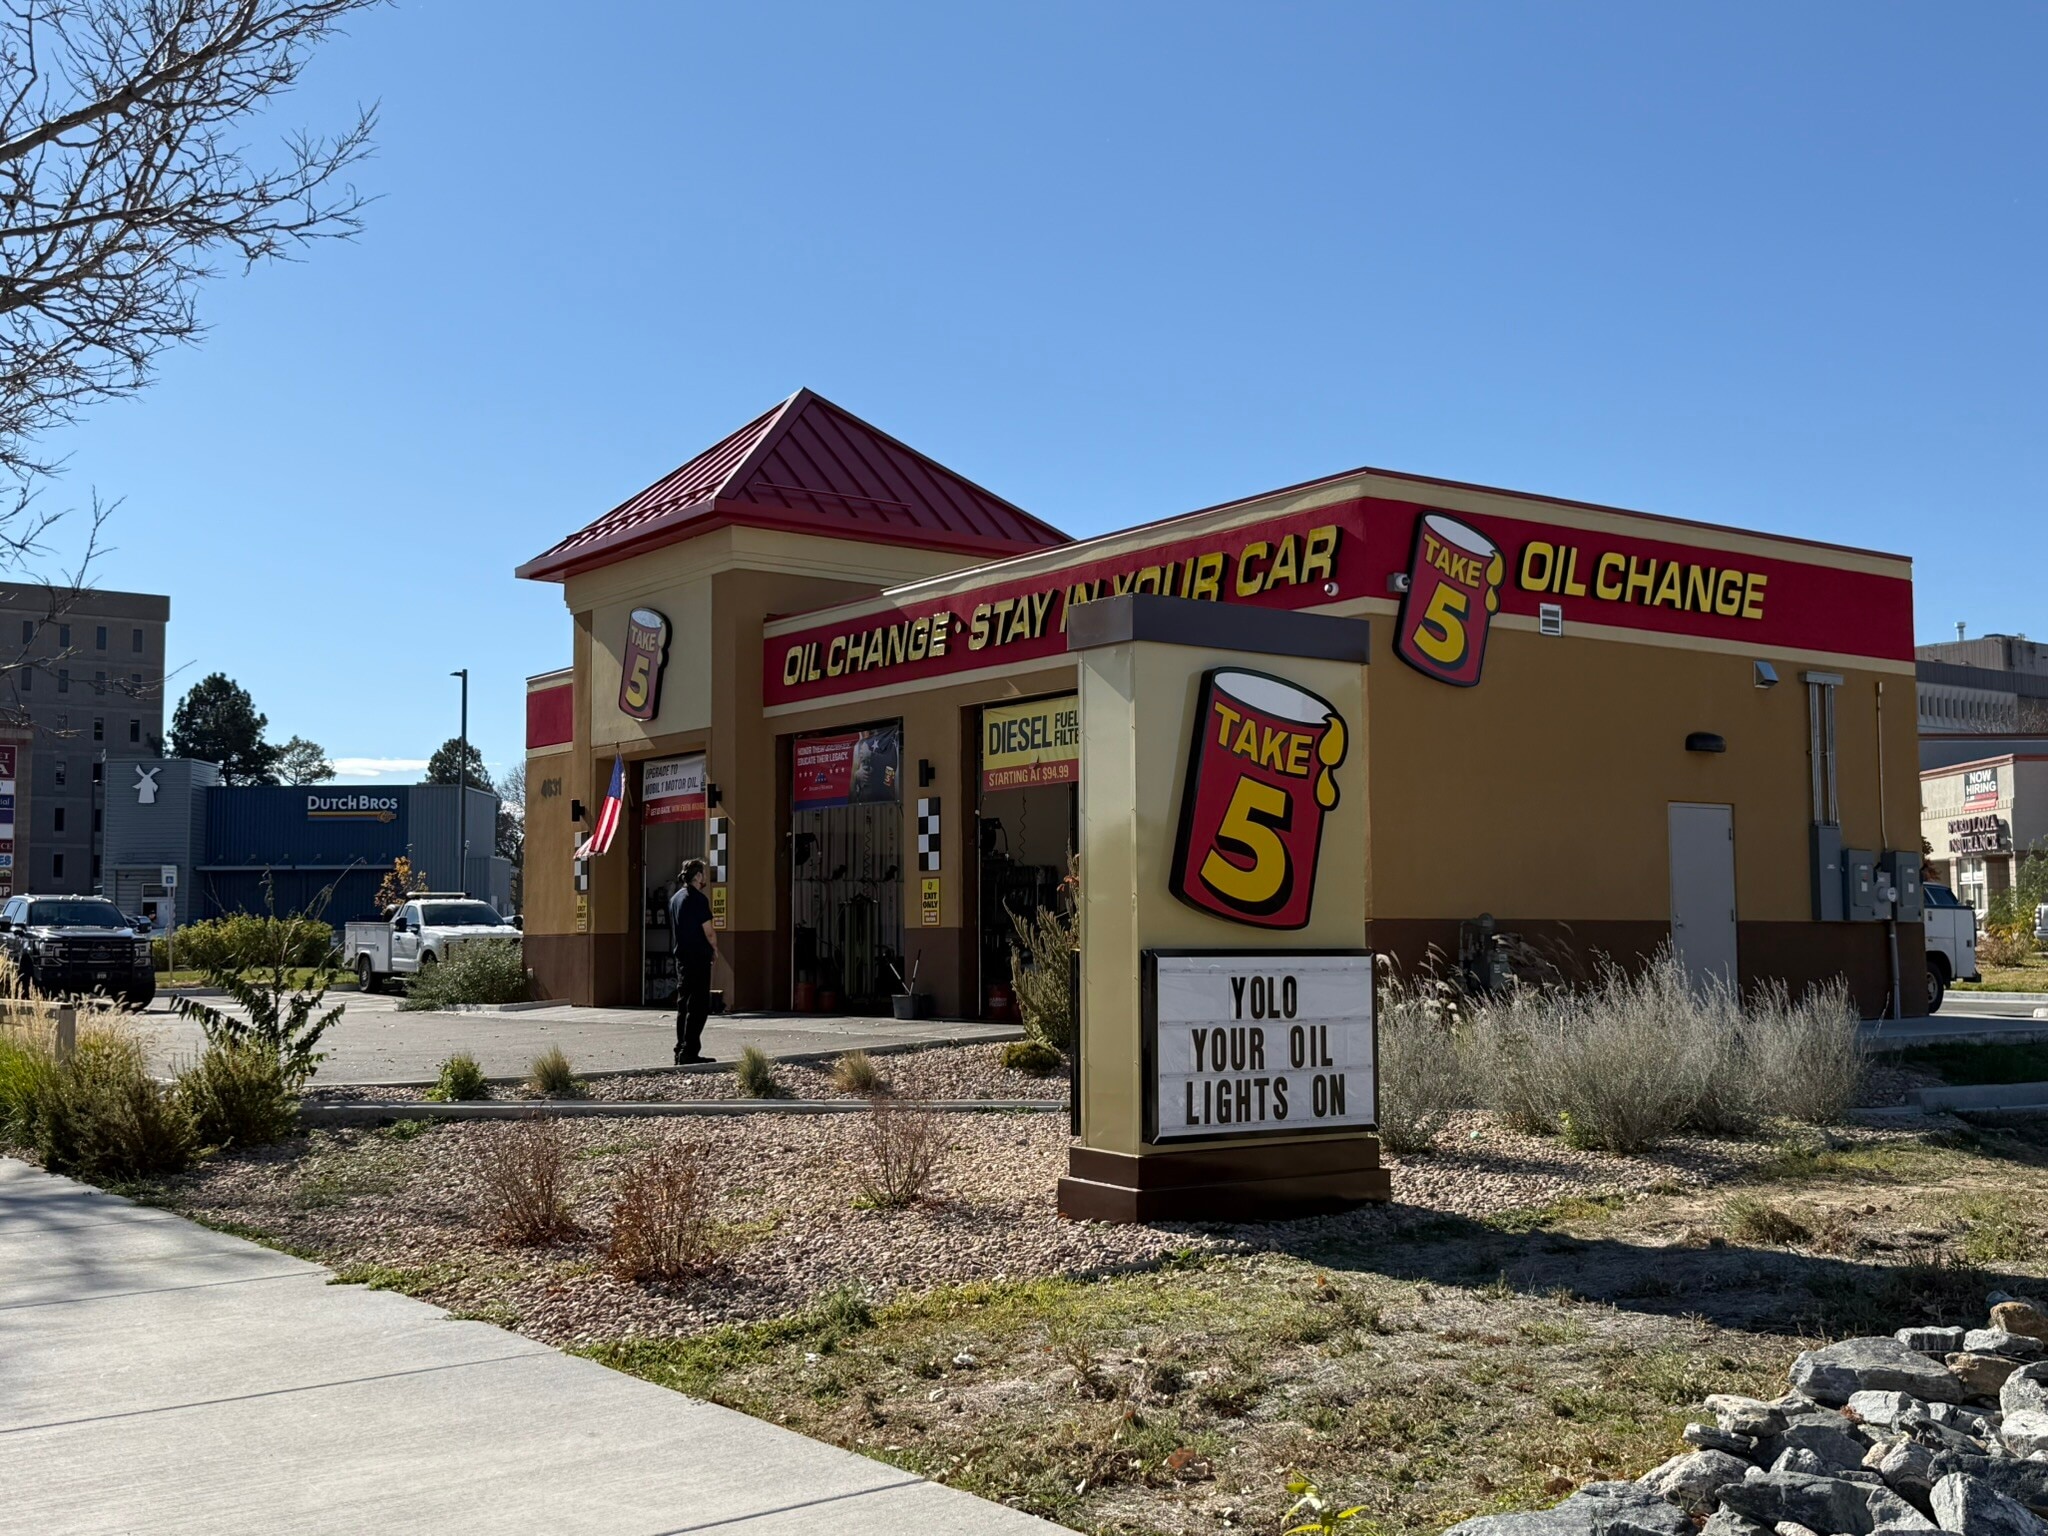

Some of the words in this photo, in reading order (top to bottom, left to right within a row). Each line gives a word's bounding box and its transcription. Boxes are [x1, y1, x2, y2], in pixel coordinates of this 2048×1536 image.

[1423, 534, 1483, 588] TAKE
[1520, 541, 1587, 597] OIL
[1595, 552, 1768, 620] CHANGE
[783, 642, 821, 686] OIL
[826, 611, 951, 677] CHANGE
[968, 588, 1056, 650] STAY
[1235, 525, 1338, 597] CAR
[1412, 581, 1468, 663] 5
[631, 626, 657, 651] TAKE
[625, 654, 650, 708] 5
[1054, 710, 1079, 729] FUEL
[988, 714, 1053, 755] DIESEL
[1054, 727, 1079, 747] FILTE
[1214, 701, 1313, 776] TAKE
[645, 764, 670, 780] UPGRADE
[670, 764, 678, 776] TO
[797, 754, 816, 767] EDUCATE
[665, 777, 686, 792] MOTOR
[989, 769, 1028, 787] STARTING
[1030, 768, 1041, 781] AT
[1042, 764, 1069, 780] $94.99
[1969, 769, 1993, 784] NOW
[1966, 781, 1997, 796] HIRING
[1200, 775, 1288, 902] 5
[1949, 833, 1998, 853] INSURANCE
[714, 899, 724, 907] EXIT
[922, 901, 938, 909] ONLY
[924, 892, 938, 900] EXIT
[1231, 975, 1297, 1020] YOLO
[1191, 1027, 1265, 1072] YOUR
[1290, 1025, 1333, 1069] OIL
[1186, 1076, 1289, 1125] LIGHTS
[1312, 1073, 1346, 1118] ON
